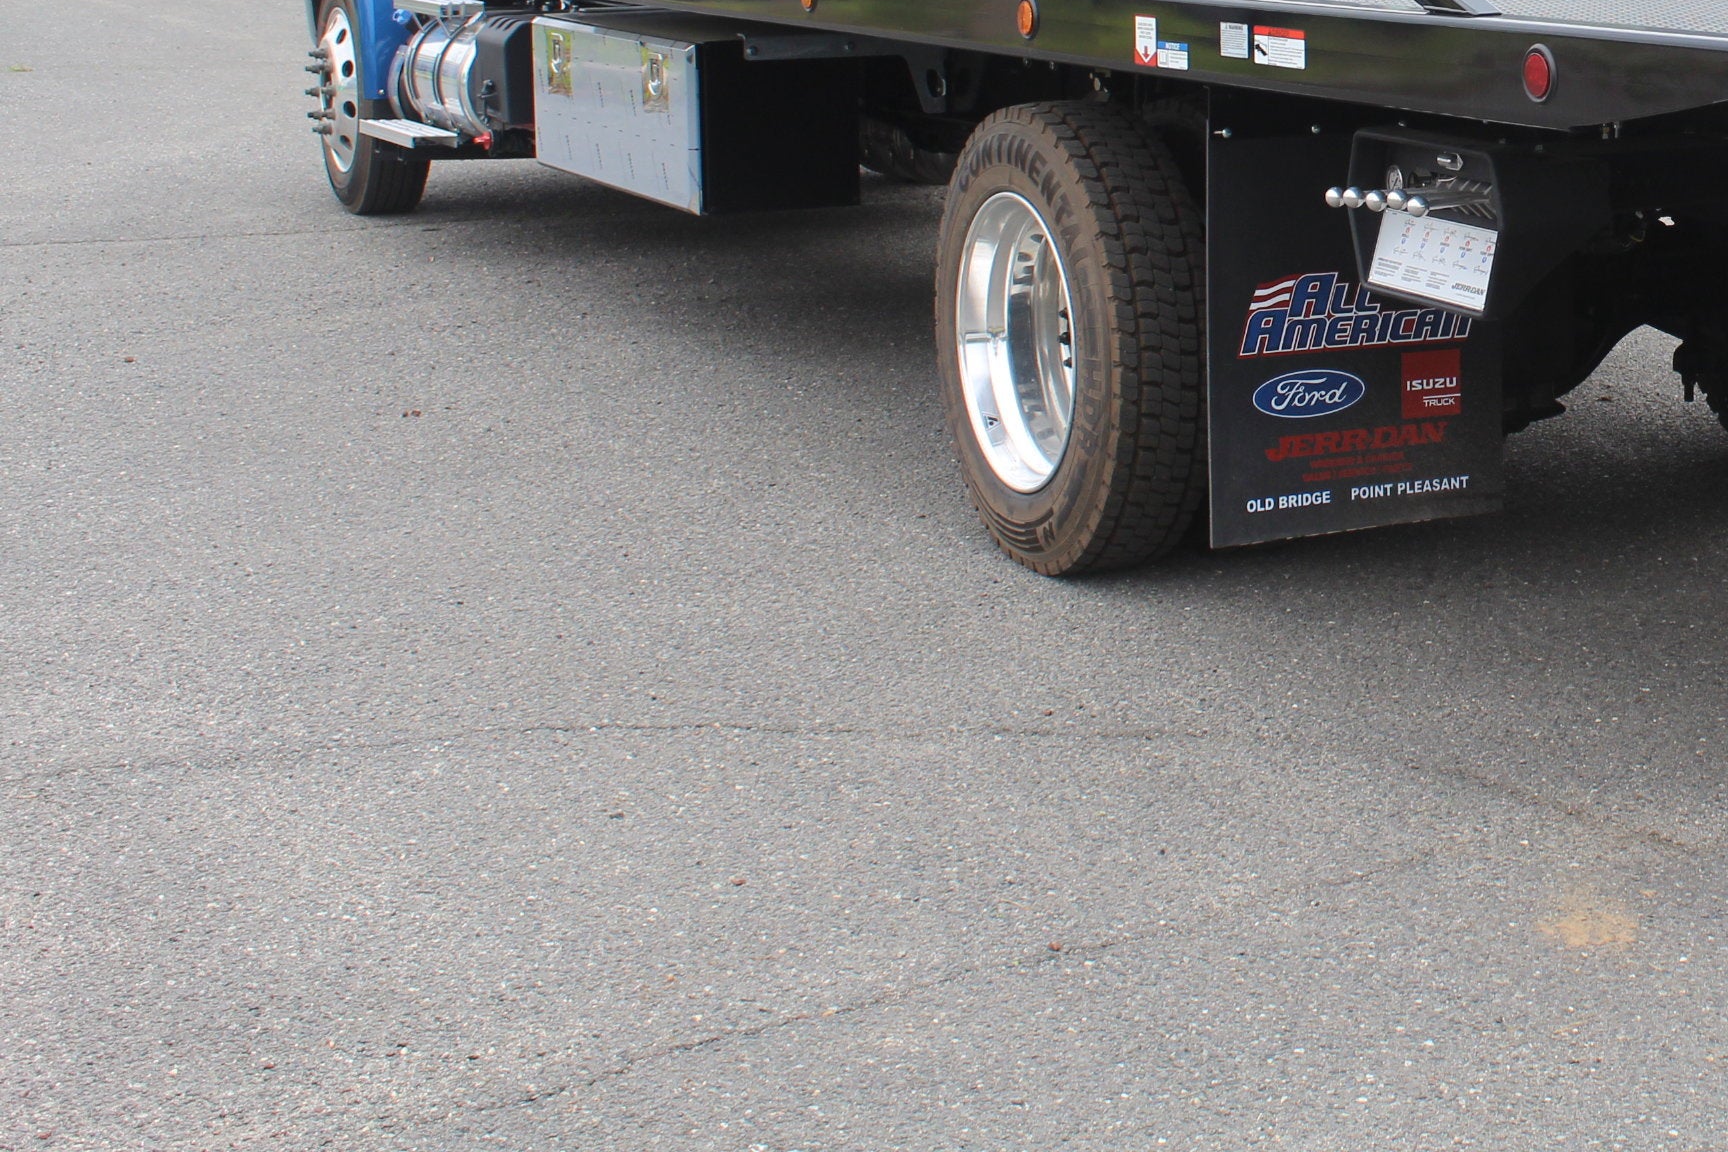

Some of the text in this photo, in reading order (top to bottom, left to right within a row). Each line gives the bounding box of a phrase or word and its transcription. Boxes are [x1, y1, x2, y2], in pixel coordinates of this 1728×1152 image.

[1289, 272, 1380, 319] ALL
[1239, 307, 1473, 357] AMERICAN
[1271, 377, 1348, 411] Ford
[1406, 377, 1457, 391] ISUZU
[1423, 398, 1455, 408] TRUCK
[1265, 421, 1449, 461] JERR-DAN
[1246, 475, 1470, 513] OLD BRIDGE POINT PLEASANT
